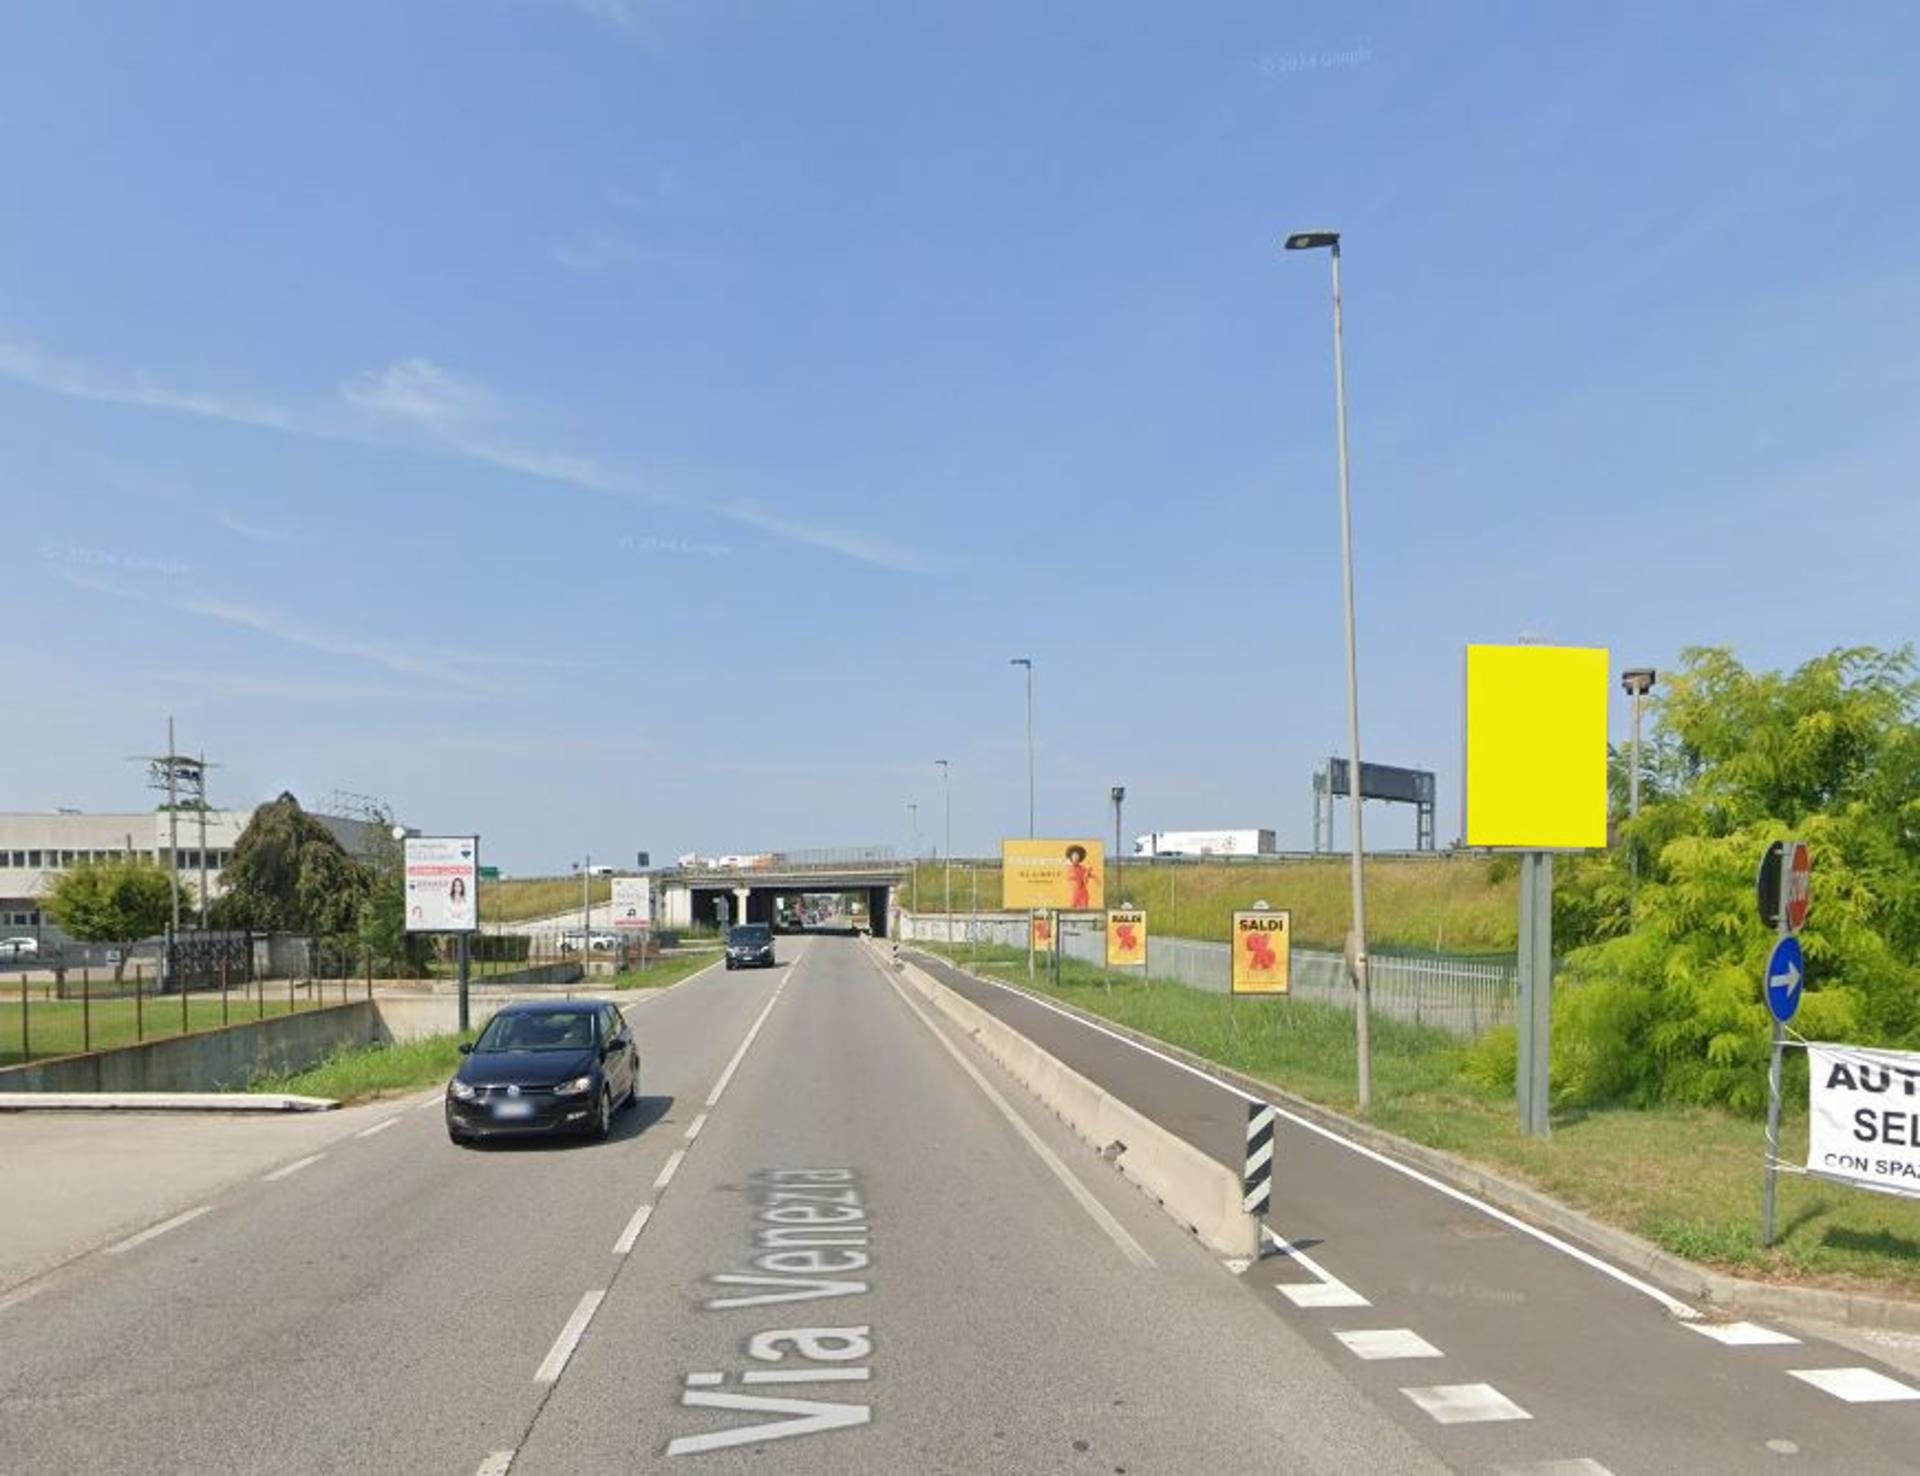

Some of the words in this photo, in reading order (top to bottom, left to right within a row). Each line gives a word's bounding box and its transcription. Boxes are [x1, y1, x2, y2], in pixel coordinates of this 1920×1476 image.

[1239, 919, 1283, 932] SALDI
[1826, 1063, 1920, 1096] AUT
[1824, 1152, 1868, 1172] CON
[1875, 1159, 1920, 1179] SPA
